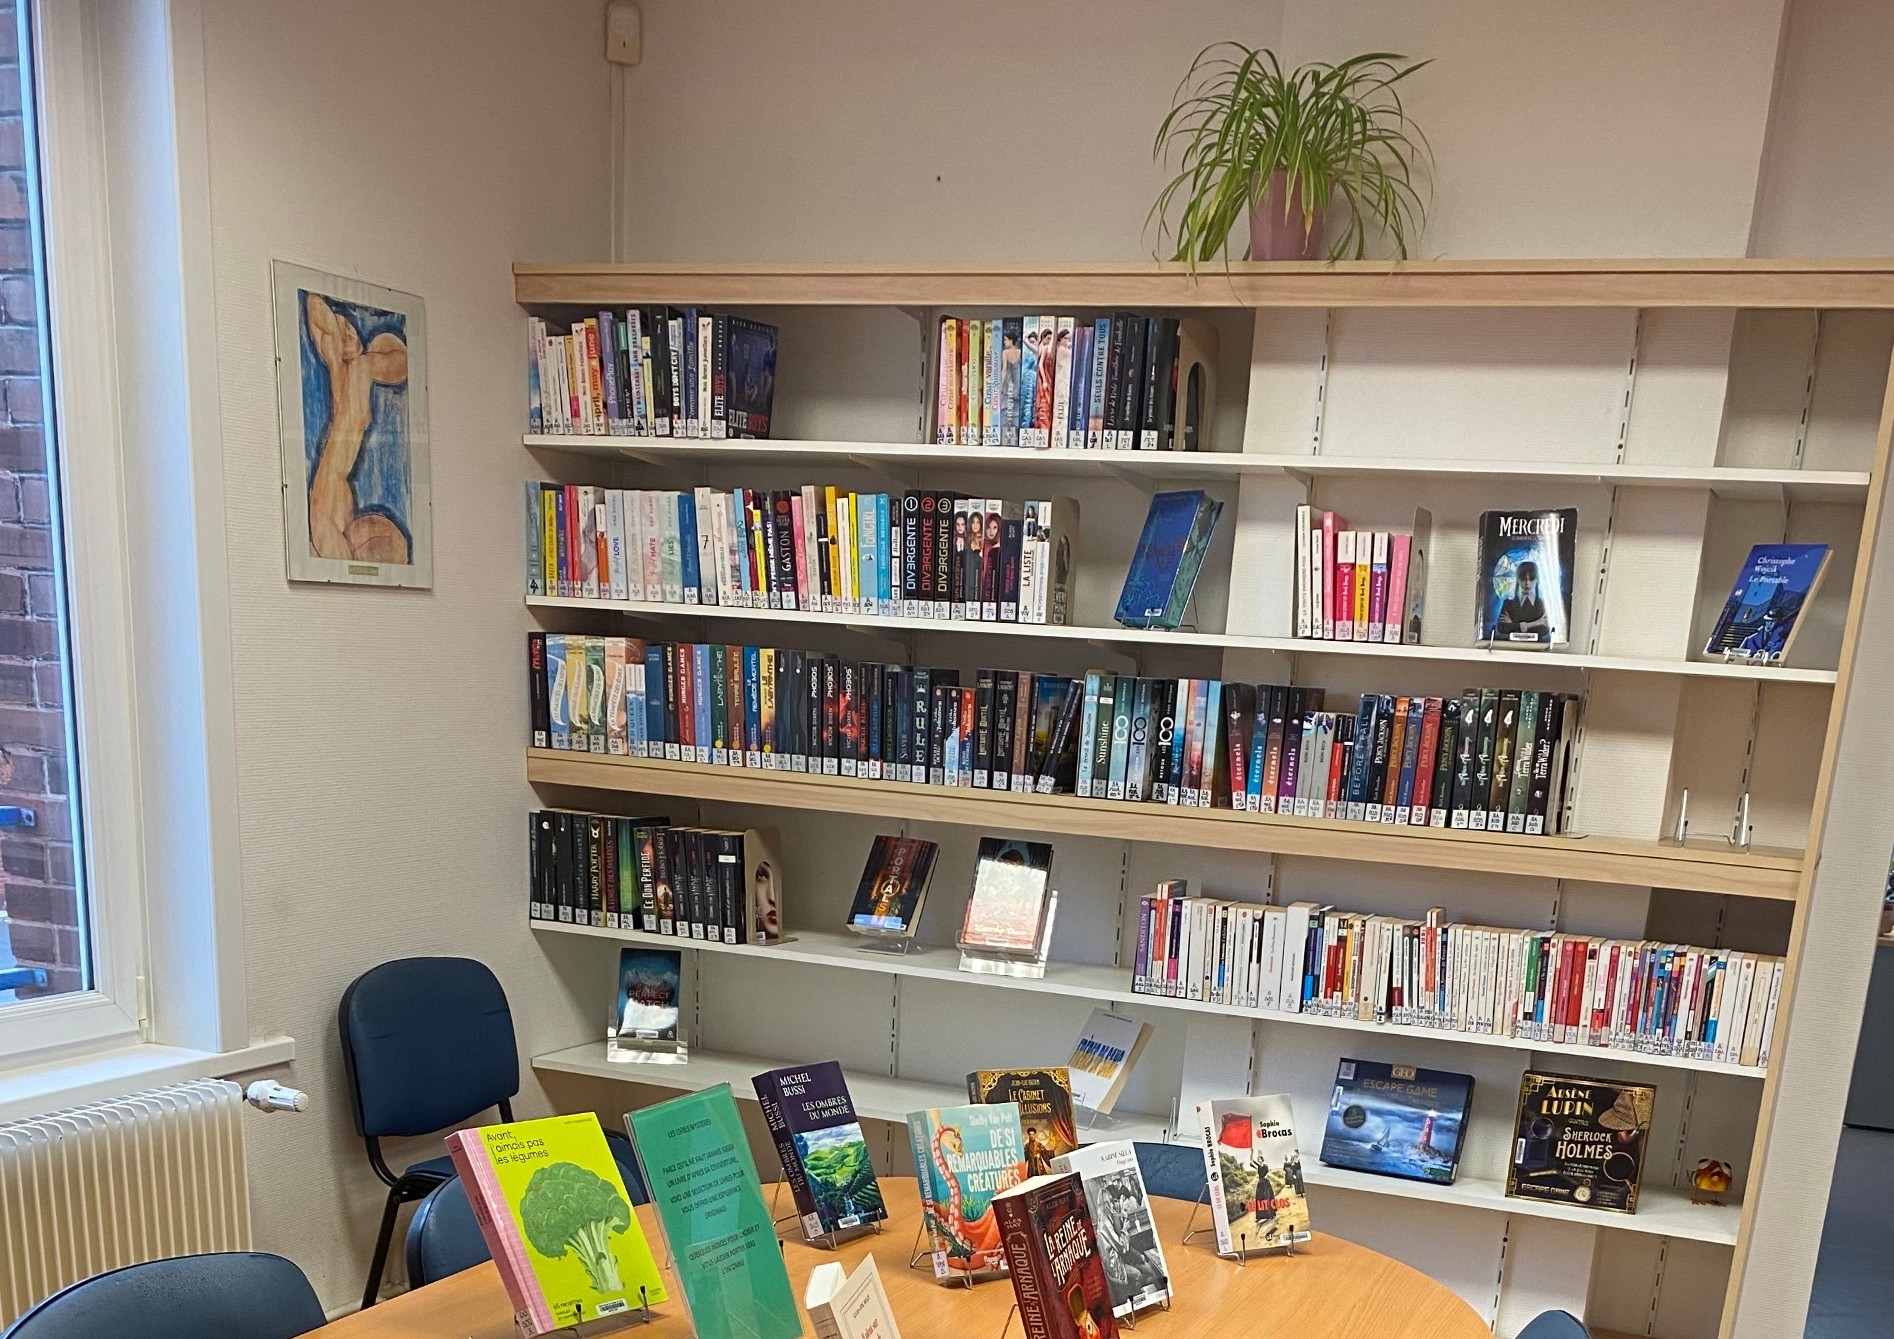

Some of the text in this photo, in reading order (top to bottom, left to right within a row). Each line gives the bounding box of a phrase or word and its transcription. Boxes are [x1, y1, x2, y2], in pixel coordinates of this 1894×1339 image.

[1096, 346, 1104, 377] CONTRE
[714, 374, 724, 416] ELITE BOYS
[1094, 380, 1102, 403] SEULS
[728, 409, 768, 432] ELITE BOYS
[1498, 515, 1565, 537] MERCREDI
[701, 535, 708, 550] 7
[780, 530, 791, 571] GASTON
[1023, 549, 1034, 586] LA LISTE
[1756, 556, 1796, 566] Christophe
[1759, 575, 1789, 585] Portable
[915, 700, 926, 762] RULE
[1114, 715, 1129, 745] 100
[1096, 720, 1110, 764] Sunshine
[1253, 745, 1262, 783] éternels
[1267, 746, 1278, 784] éternels
[1352, 753, 1364, 795] BEFORE
[1361, 715, 1370, 741] FALL
[1374, 745, 1384, 764] PERCY
[1285, 747, 1296, 786] éternels
[591, 877, 599, 900] HARRY
[779, 1072, 812, 1086] MICHEL
[1392, 1068, 1414, 1078] GEO
[783, 1086, 806, 1096] BUSSI
[1008, 1089, 1045, 1103] LE CABINET
[1363, 1079, 1437, 1098] ESCAPE GAME
[1547, 1085, 1592, 1099] ARSÈNE
[760, 1093, 780, 1132] MICHEL
[801, 1095, 847, 1112] LES OMBRES
[809, 1105, 851, 1120] DU MONDE
[1541, 1100, 1594, 1116] LUPIN
[771, 1101, 786, 1129] BUSSI
[969, 1112, 1013, 1127] Shelby Van Pelt
[1260, 1119, 1279, 1127] Sophie
[528, 1138, 545, 1149] pas
[990, 1127, 1016, 1149] DE SI
[1204, 1126, 1212, 1148] BROCAS
[1261, 1129, 1293, 1138] Brocas
[1563, 1127, 1612, 1143] SHERLOCK
[495, 1147, 549, 1165] les légumes
[778, 1142, 797, 1177] OMBRES
[784, 1140, 801, 1170] MONDE
[944, 1149, 1018, 1173] REMARQUABLES
[1100, 1152, 1119, 1162] KARINE
[1556, 1141, 1613, 1159] HOLMES
[918, 1151, 931, 1199] REMARQUABLES
[967, 1169, 1021, 1193] CRÉATURES
[1521, 1183, 1570, 1195] ESCAPE GAME
[1257, 1199, 1269, 1210] LIT
[1271, 1197, 1290, 1209] CLOS
[1043, 1231, 1055, 1262] LA
[1053, 1215, 1078, 1250] REINE
[1050, 1231, 1092, 1286] L'ARNAQUE
